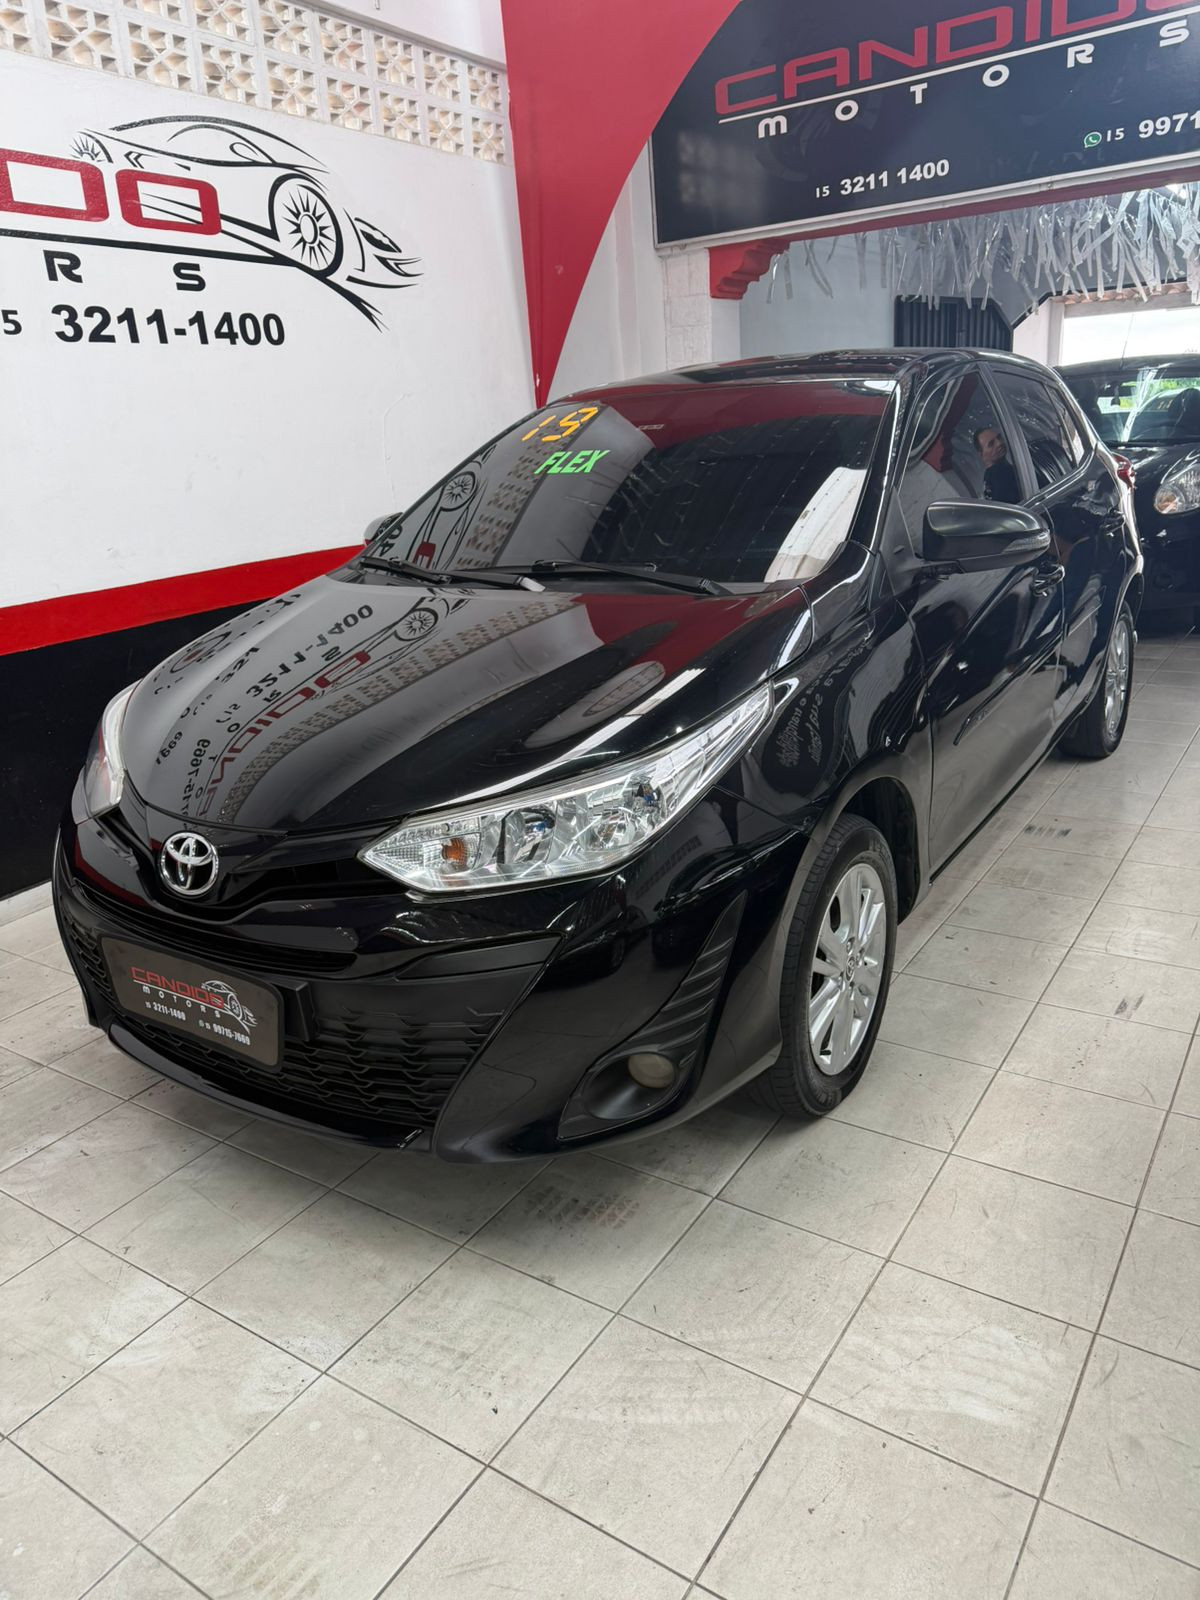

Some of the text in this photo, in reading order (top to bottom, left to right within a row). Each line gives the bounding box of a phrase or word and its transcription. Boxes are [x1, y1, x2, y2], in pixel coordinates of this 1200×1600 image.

[714, 0, 1200, 115] CANDID
[1106, 127, 1125, 142] 15
[815, 159, 950, 198] 15 3211 1400
[51, 303, 285, 346] 3211-1400
[534, 450, 611, 474] FLEX
[130, 966, 225, 1009] CANDIDO
